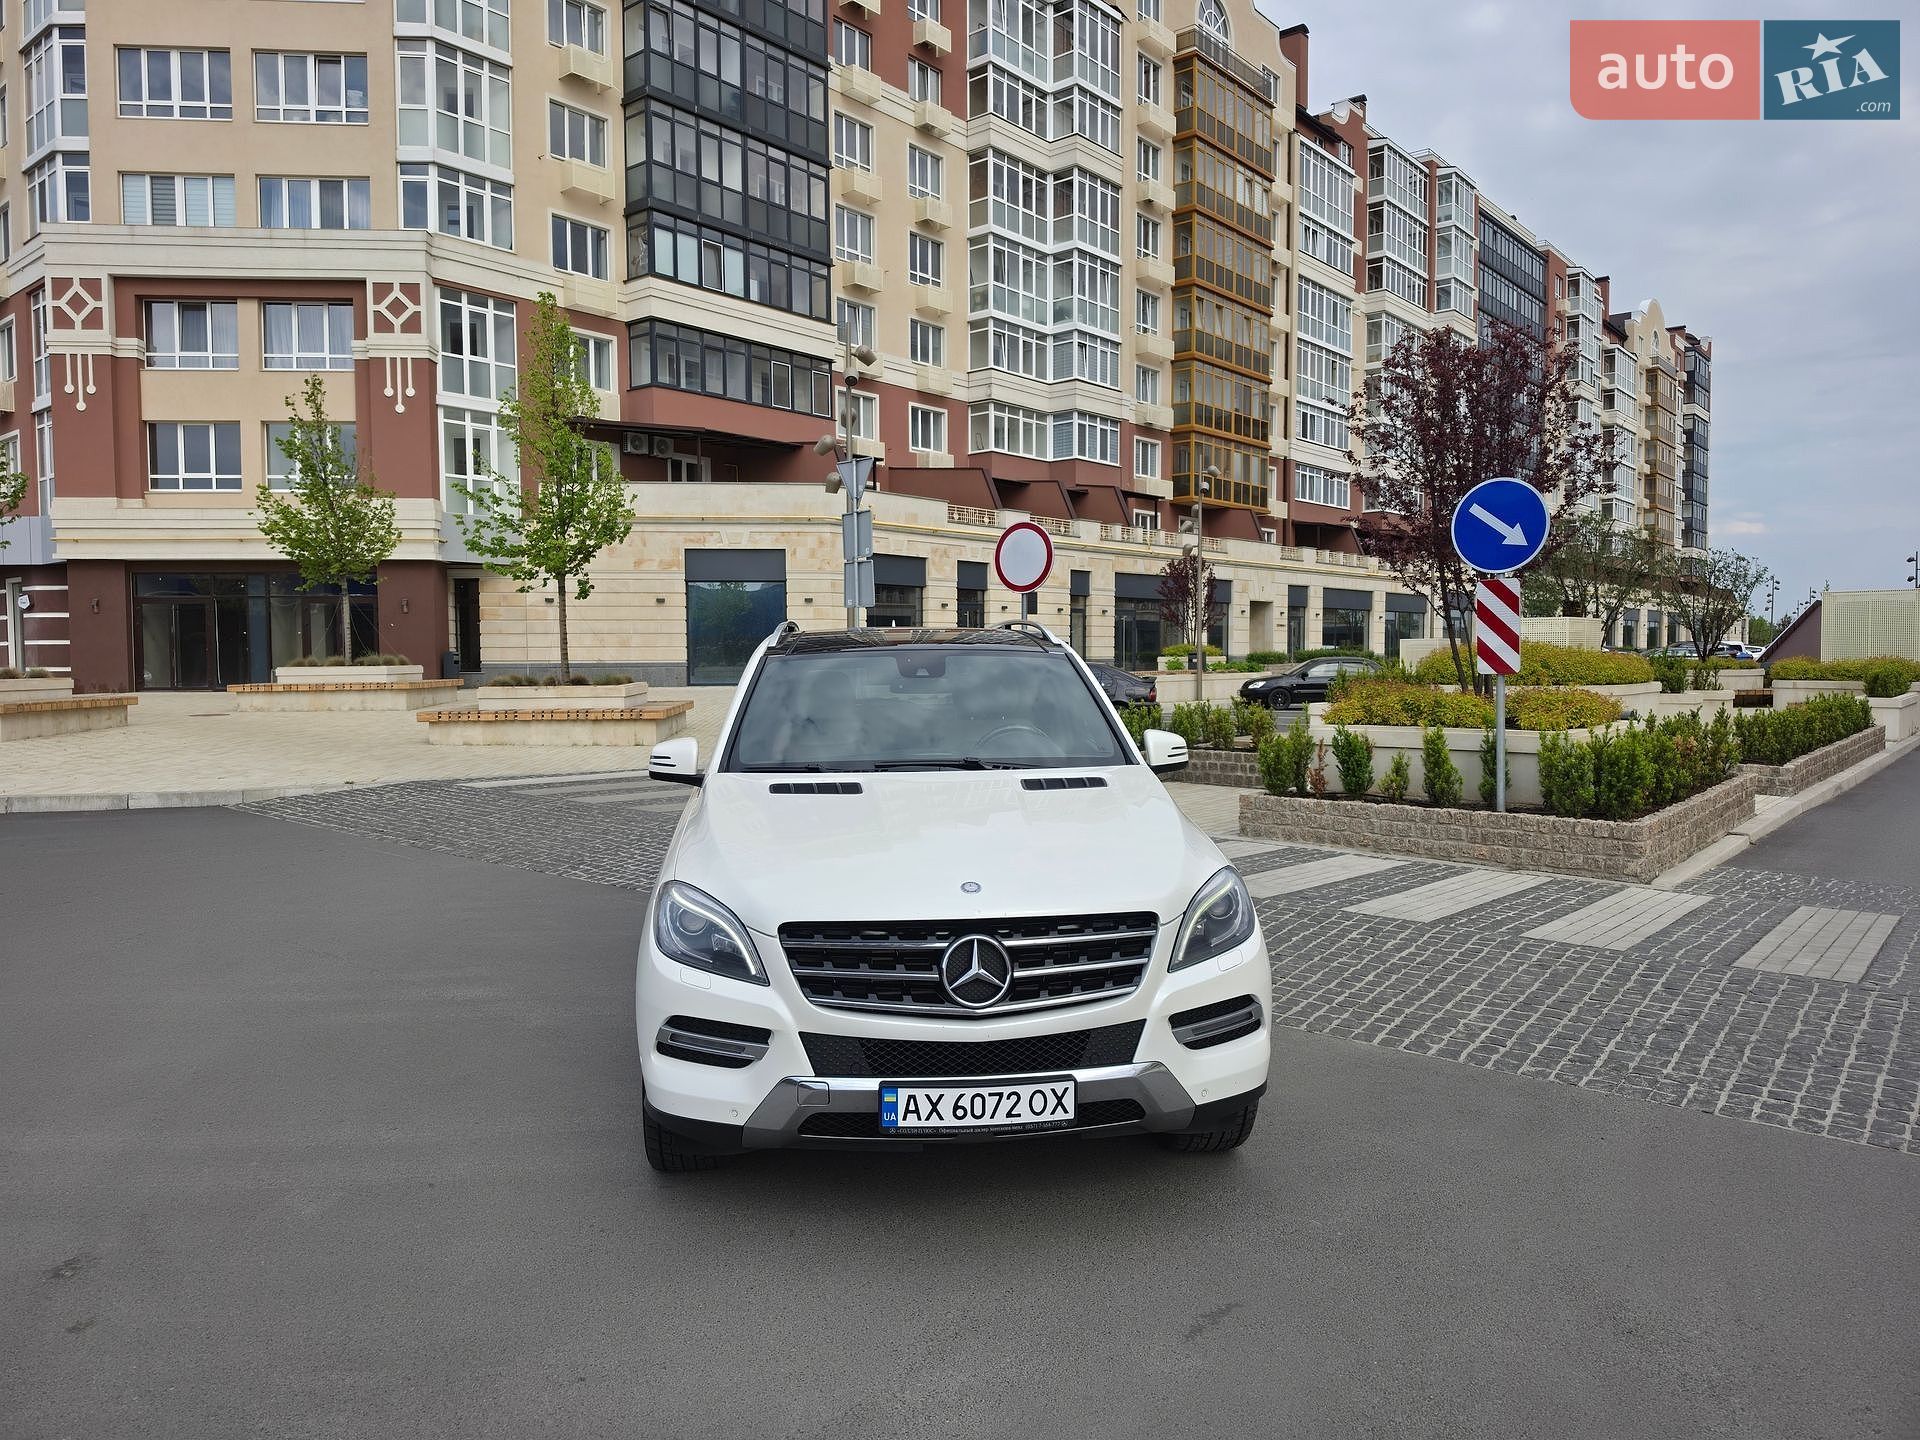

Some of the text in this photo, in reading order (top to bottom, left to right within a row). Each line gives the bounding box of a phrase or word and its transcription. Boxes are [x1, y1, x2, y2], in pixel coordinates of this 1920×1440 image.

[901, 1087, 1070, 1122] AX 6072 OX
[884, 1113, 897, 1121] UA
